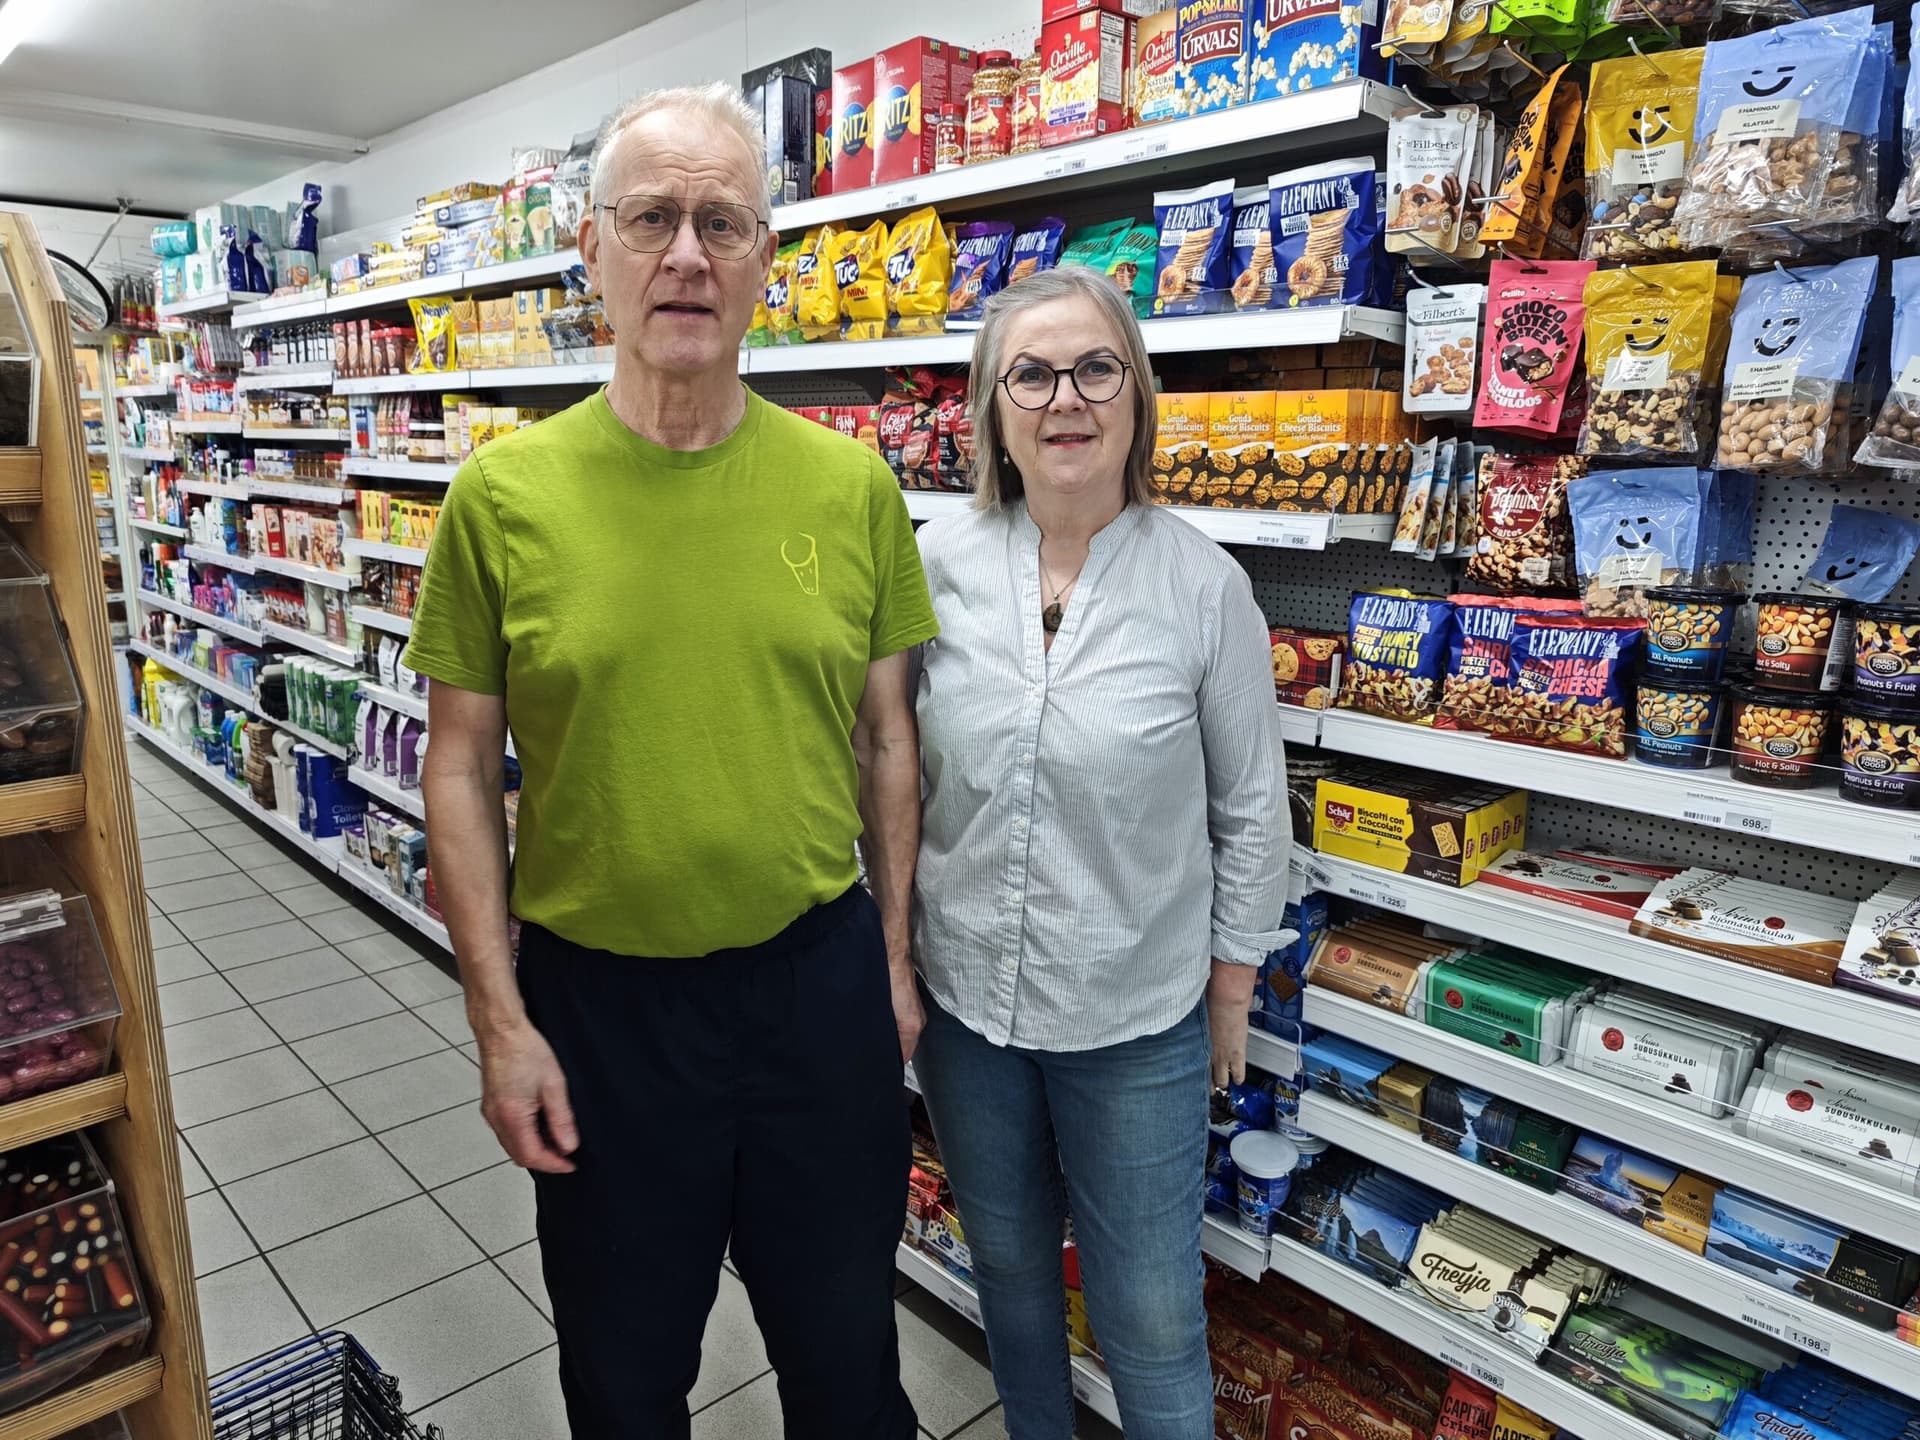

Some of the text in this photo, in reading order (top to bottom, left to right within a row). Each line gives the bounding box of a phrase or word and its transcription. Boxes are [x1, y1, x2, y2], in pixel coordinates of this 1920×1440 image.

[1145, 33, 1177, 62] Orvill
[1182, 27, 1239, 60] ÚRVALS
[1050, 40, 1086, 69] Orville
[883, 94, 911, 132] RITZ
[841, 110, 868, 142] RITZ
[1413, 140, 1458, 150] Filbert's
[1280, 180, 1339, 217] ELEPHANT
[1164, 201, 1210, 230] ELEPHANT
[1236, 202, 1270, 229] ELEPH
[835, 263, 859, 285] TUC
[767, 283, 788, 308] TUC
[1423, 307, 1465, 320] Filbert's
[1502, 300, 1568, 323] CHOCO
[1176, 423, 1204, 433] Biscuits
[1212, 423, 1270, 433] Cheese Biscuits
[1228, 414, 1252, 424] Gouda
[1280, 422, 1342, 433] Cheese Biscuits
[1297, 414, 1322, 424] Gouda
[1360, 596, 1416, 629] ELEPHANT
[1463, 608, 1516, 641] ELEPHA
[1380, 630, 1422, 651] HONEY
[1528, 629, 1604, 657] ELEPHANT
[1352, 641, 1419, 669] MUSTARD
[1663, 654, 1693, 665] Peanuts
[1771, 660, 1790, 671] Salty
[1872, 658, 1898, 667] SNACK
[1523, 656, 1609, 680] SRIRACHA
[1872, 663, 1898, 671] FOODS
[1548, 678, 1608, 698] CHEESE
[1857, 676, 1917, 692] Peanuts & Fruit
[1652, 739, 1682, 751] Peanuts
[1769, 741, 1794, 749] SNACK
[1755, 759, 1770, 769] Hot
[1771, 761, 1778, 770] &
[1780, 762, 1801, 773] Salty
[1861, 756, 1887, 765] SNACK
[1861, 761, 1887, 770] FOODS
[1844, 772, 1905, 791] Peanuts & Fruit
[1357, 807, 1405, 825] Biscotti con
[1358, 816, 1402, 833] Cioccolato
[1742, 818, 1769, 831] 698,-
[1714, 905, 1761, 926] Sirius
[1634, 1033, 1660, 1048] Sirius
[1420, 1252, 1492, 1295] Freyja
[1836, 1269, 1881, 1290] ICELANDIC
[1832, 1274, 1882, 1298] CHOCOLATE
[1575, 1330, 1628, 1361] Freyja
[1792, 1332, 1828, 1353] 1.198,-
[1477, 1368, 1503, 1387] 1.098,-
[1443, 1396, 1493, 1428] CAPITAL
[1439, 1416, 1488, 1439] Crisps
[1754, 1411, 1816, 1440] Freyja
